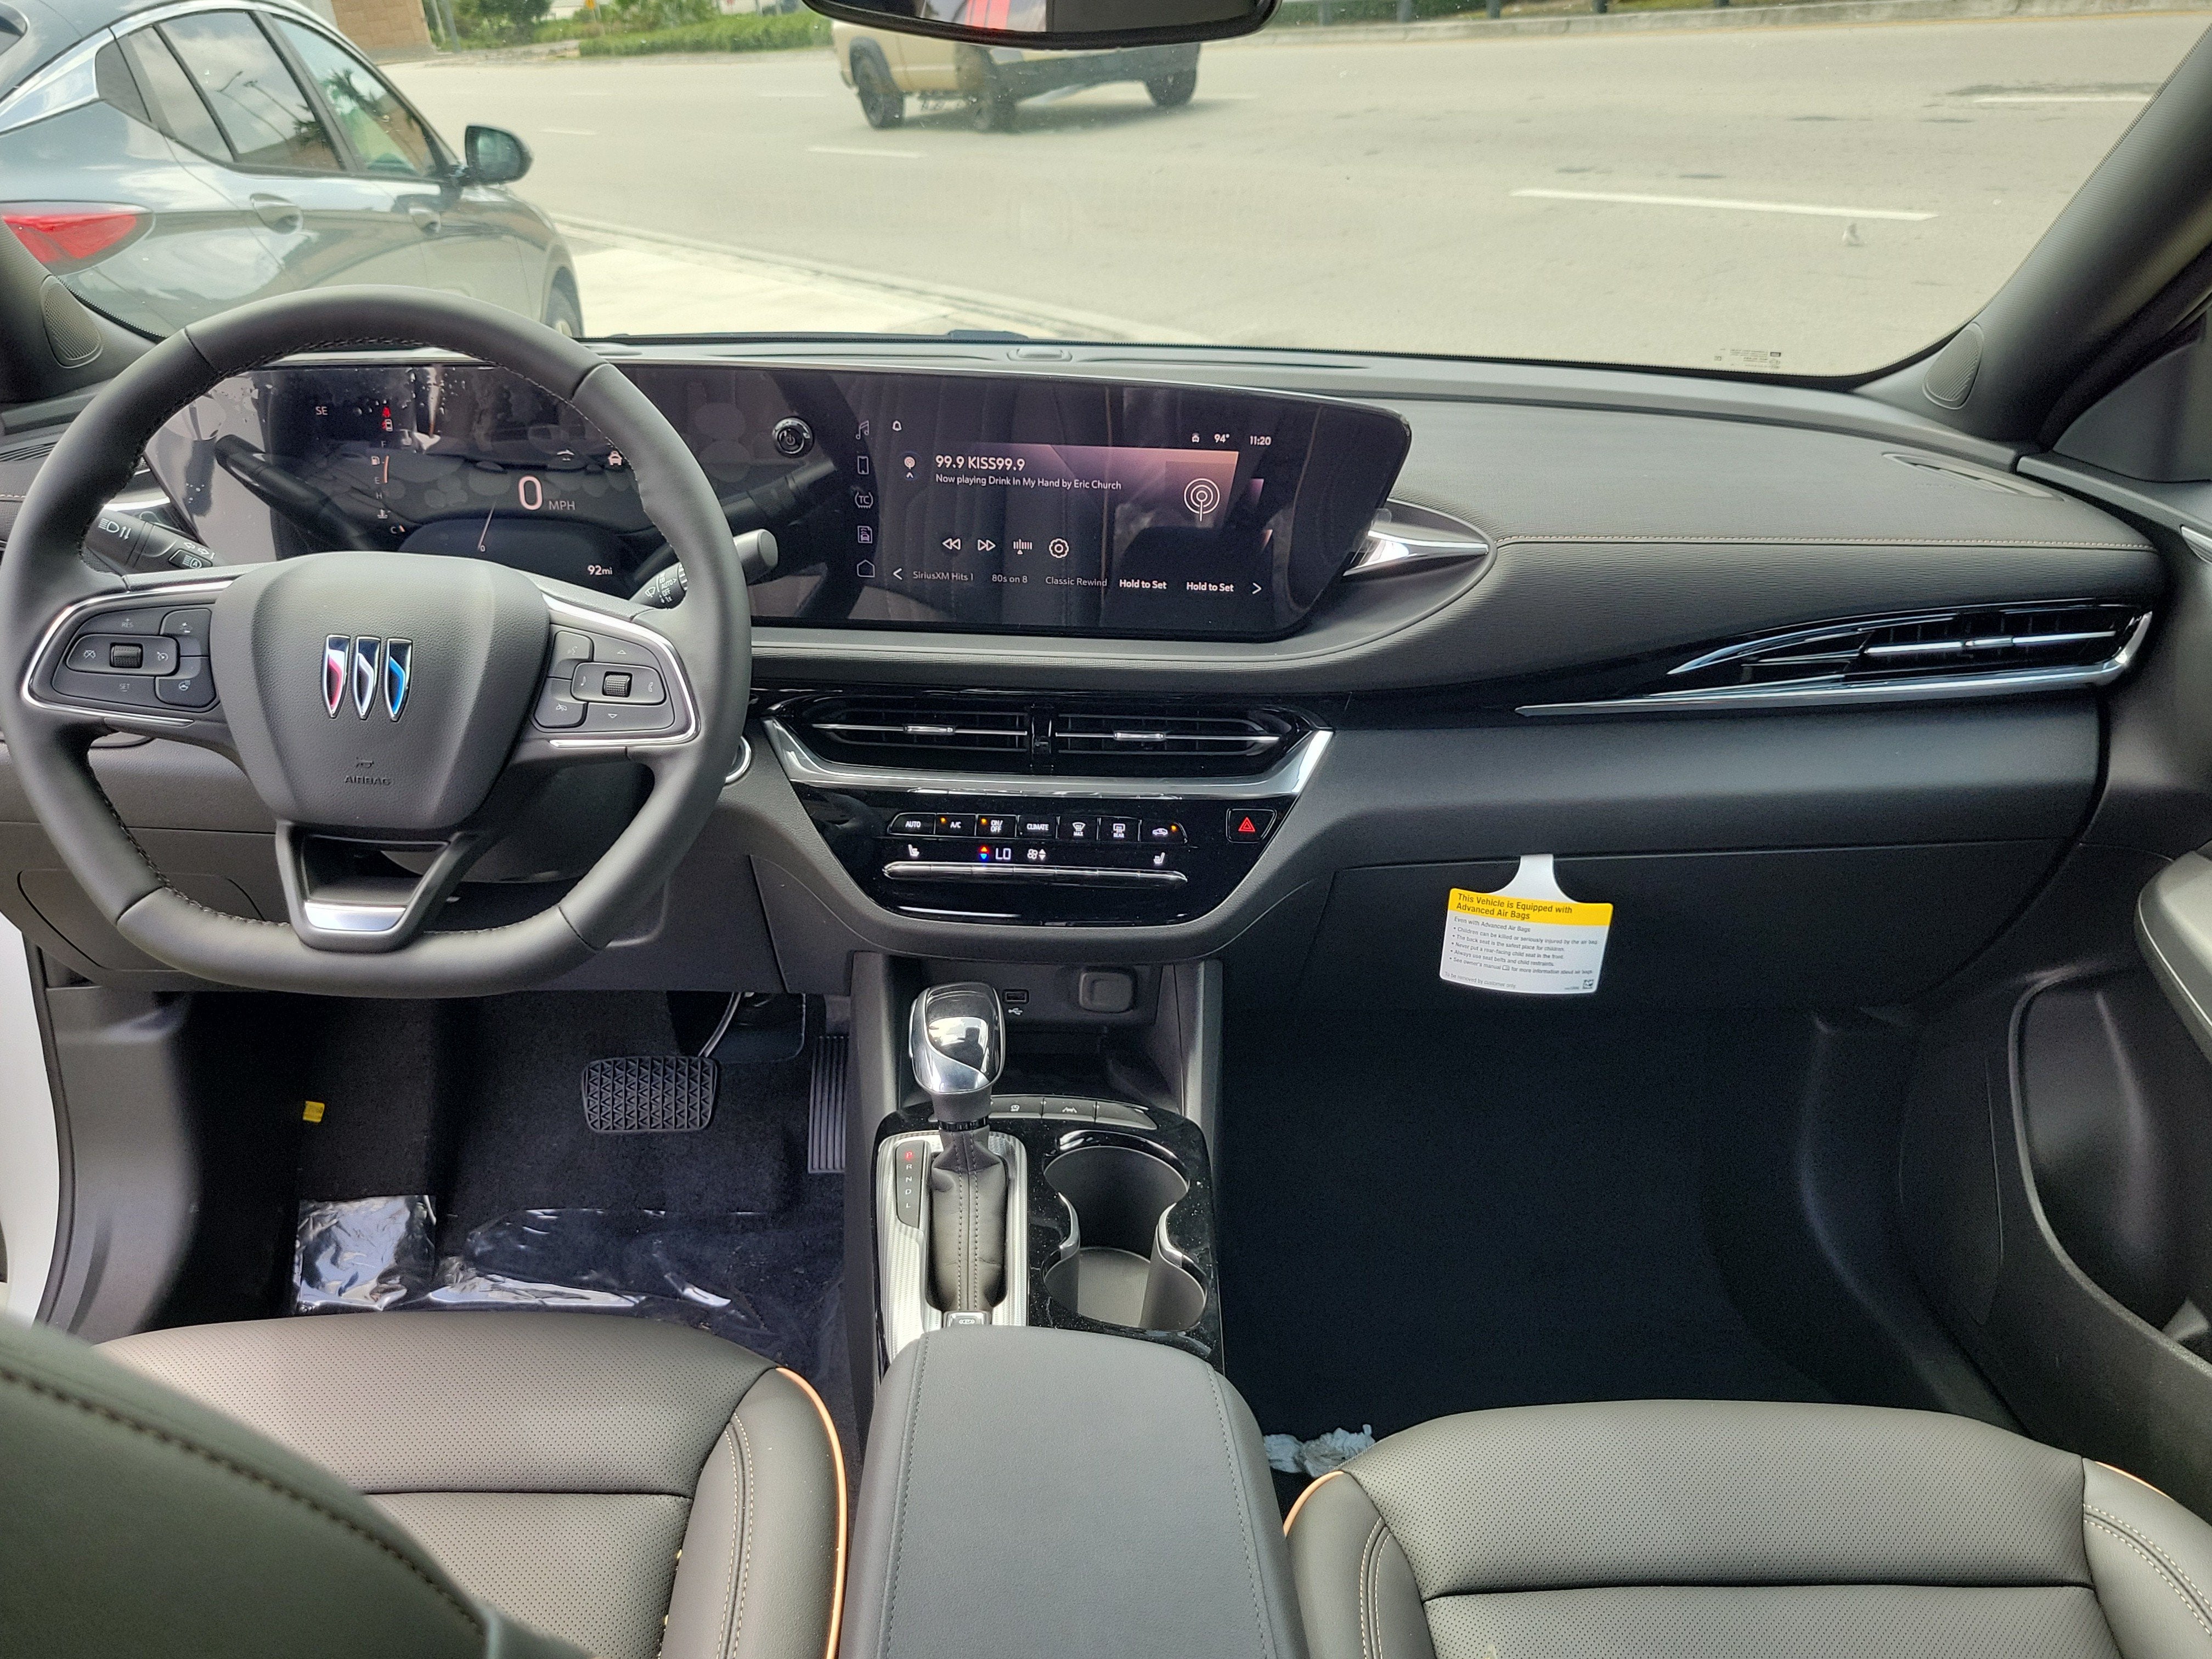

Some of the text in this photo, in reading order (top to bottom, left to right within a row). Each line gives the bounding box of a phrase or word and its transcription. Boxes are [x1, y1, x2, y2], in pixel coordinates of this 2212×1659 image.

[315, 406, 328, 415] SE
[1250, 436, 1272, 445] 11:20
[935, 455, 1025, 471] 99.9 KISS99.9
[936, 474, 1121, 489] Now playing Drink In My Hand by Eric Church
[518, 475, 576, 510] 0 MPH
[858, 495, 870, 504] TC
[913, 571, 950, 580] SiriusXM
[992, 574, 1007, 583] 80s
[1046, 577, 1107, 586] Classic Rewind
[1119, 579, 1139, 588] Hold
[1152, 580, 1167, 589] Set
[1186, 582, 1234, 592] Hold to Set
[345, 776, 392, 786] AIRBAG
[995, 848, 1012, 860] LO
[1458, 893, 1474, 902] This
[1476, 897, 1504, 907] Vehicle
[1516, 902, 1553, 912] Equipped
[1457, 903, 1494, 915] Advanced
[1511, 911, 1530, 920] Bags
